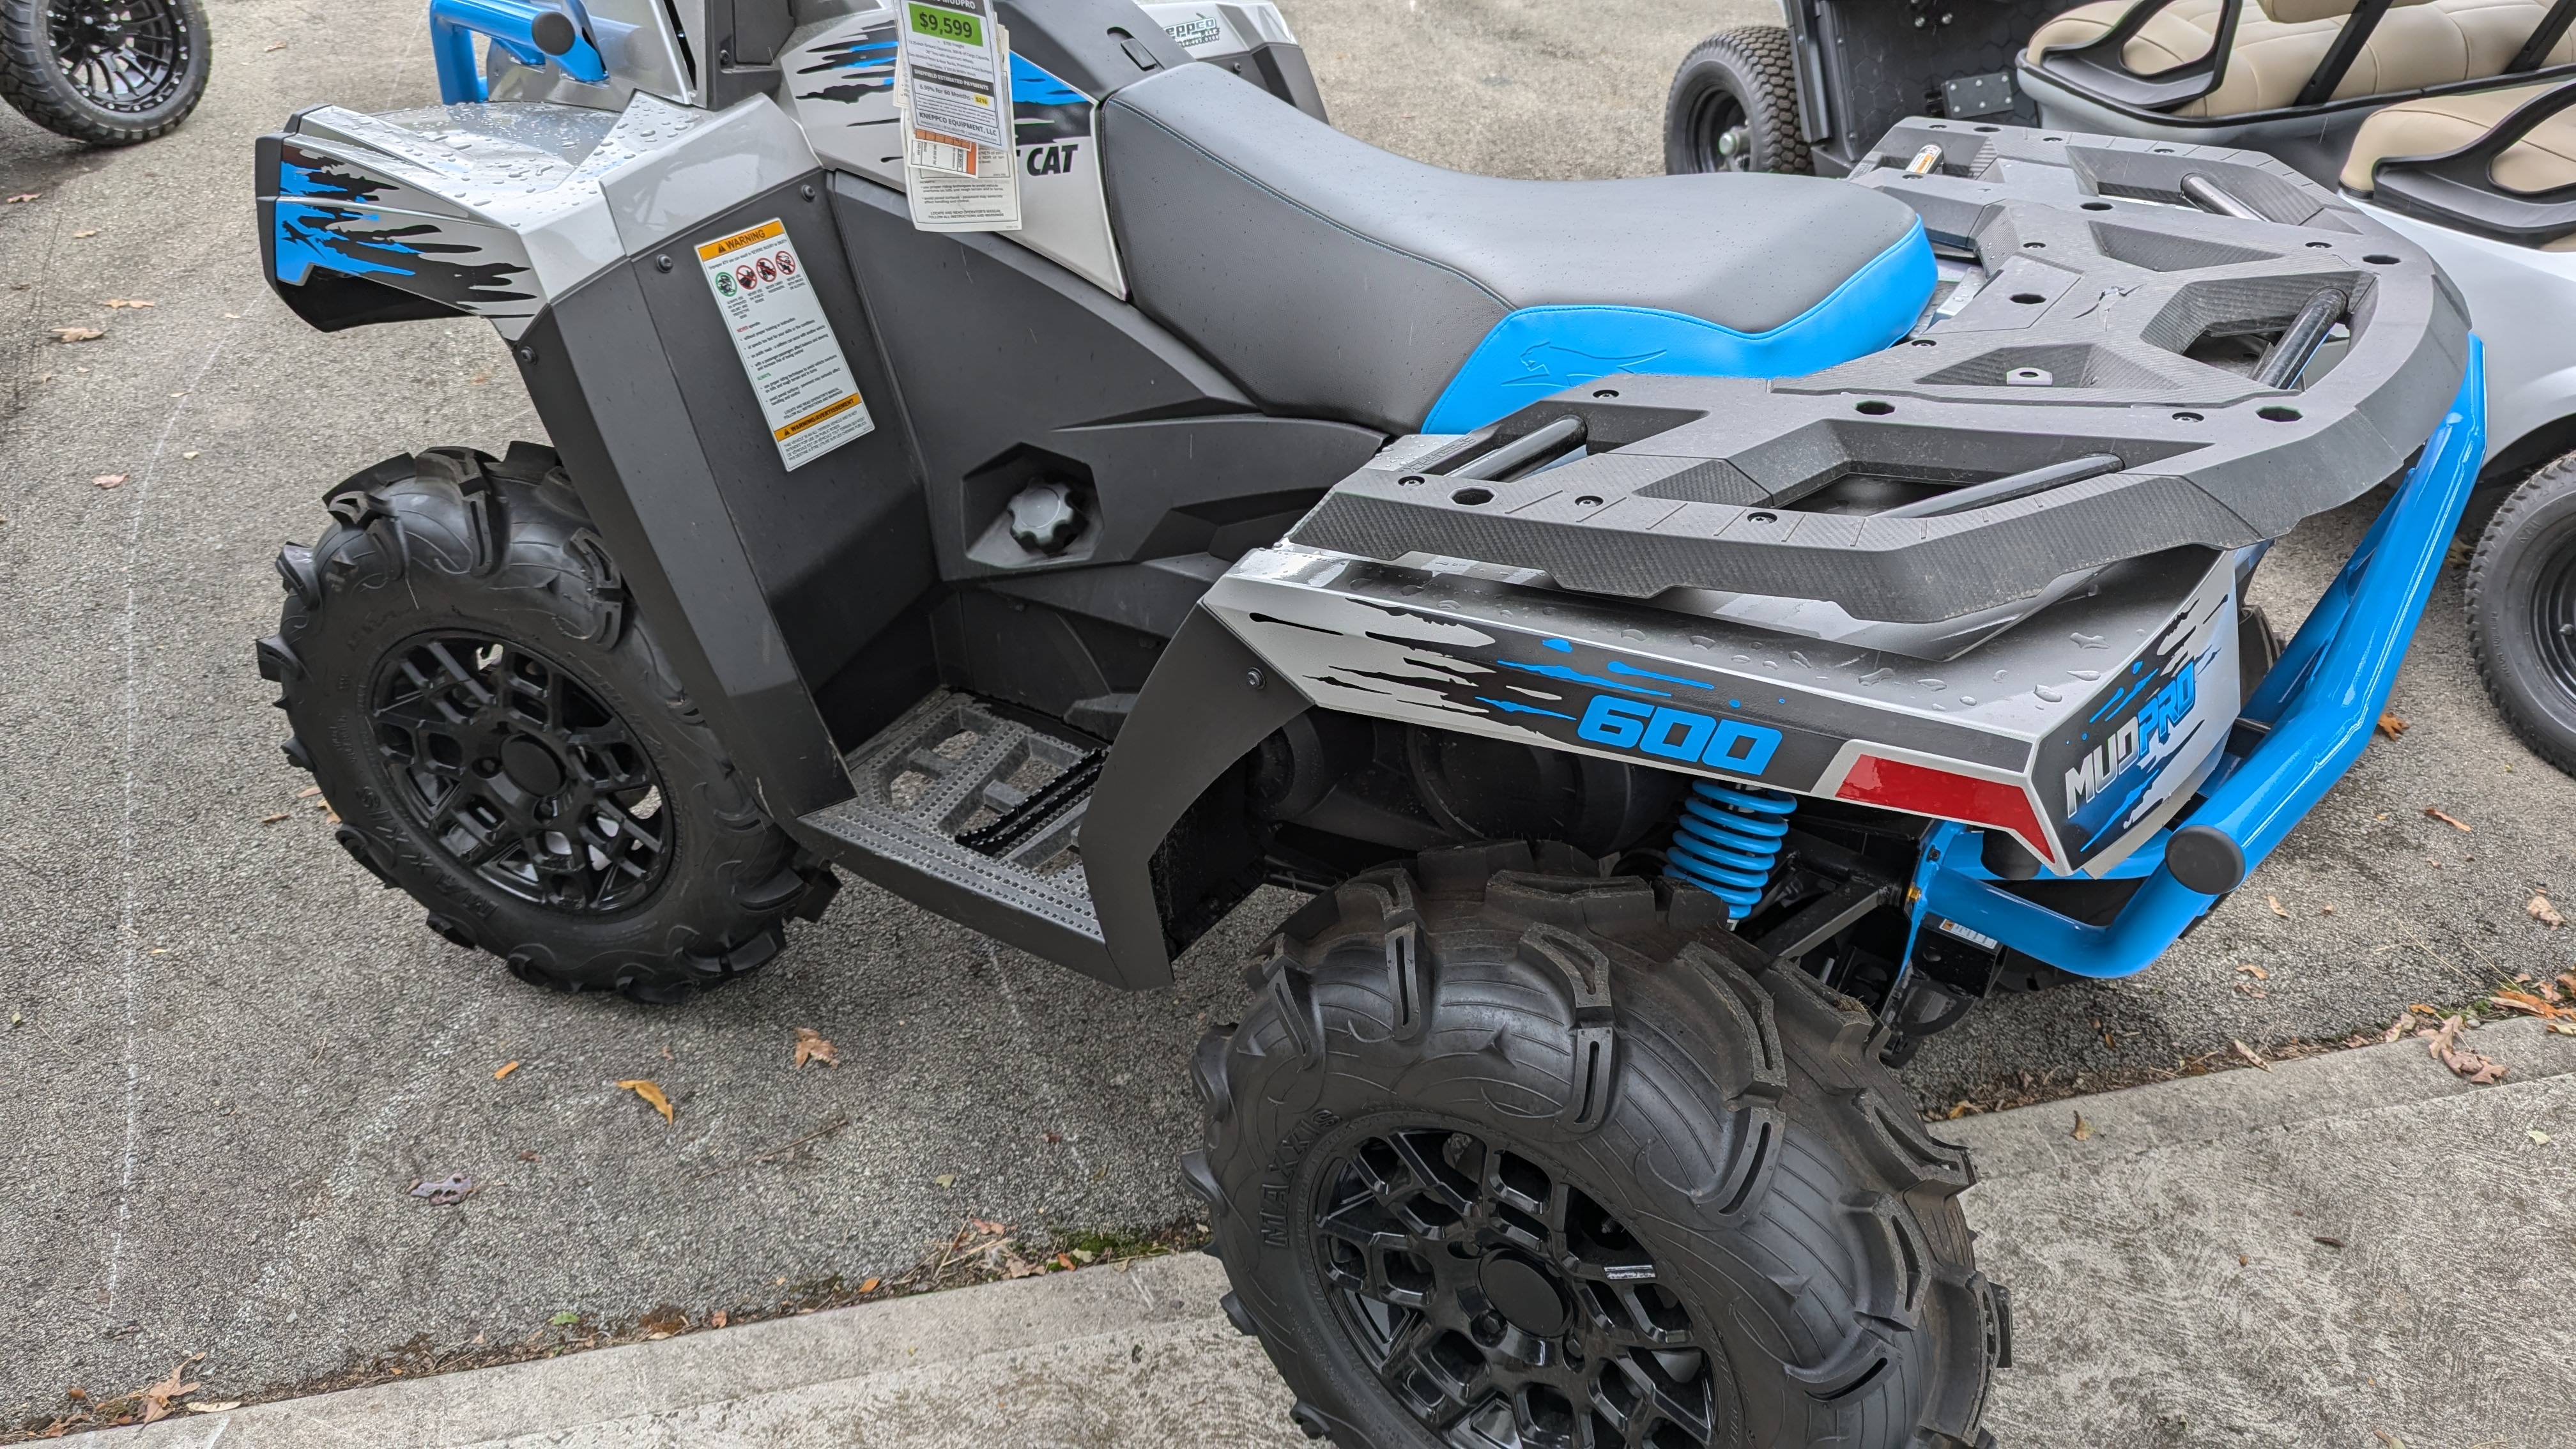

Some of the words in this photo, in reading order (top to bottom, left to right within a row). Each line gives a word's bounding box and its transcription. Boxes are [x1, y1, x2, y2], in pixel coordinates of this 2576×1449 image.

[919, 12, 972, 38] $9,599
[1165, 19, 1216, 38] eppco
[914, 69, 937, 78] SHEFFIELD
[937, 74, 963, 84] ESTIMATED
[963, 80, 988, 90] PAYMENTS
[919, 84, 934, 92] 6.99%
[951, 91, 970, 100] Months
[919, 112, 947, 123] KNEPPCO
[948, 118, 985, 133] EQUIPMENT,
[986, 128, 997, 136] LLC
[1027, 144, 1078, 176] CAT
[725, 229, 765, 249] WARNING
[791, 399, 853, 431] WARNING/AVERTISSEMENT
[1577, 694, 1783, 776] 600
[2064, 661, 2196, 819] MUDPRO
[357, 785, 500, 922] MAXXIS
[1259, 1108, 1342, 1248] MAXXIS
